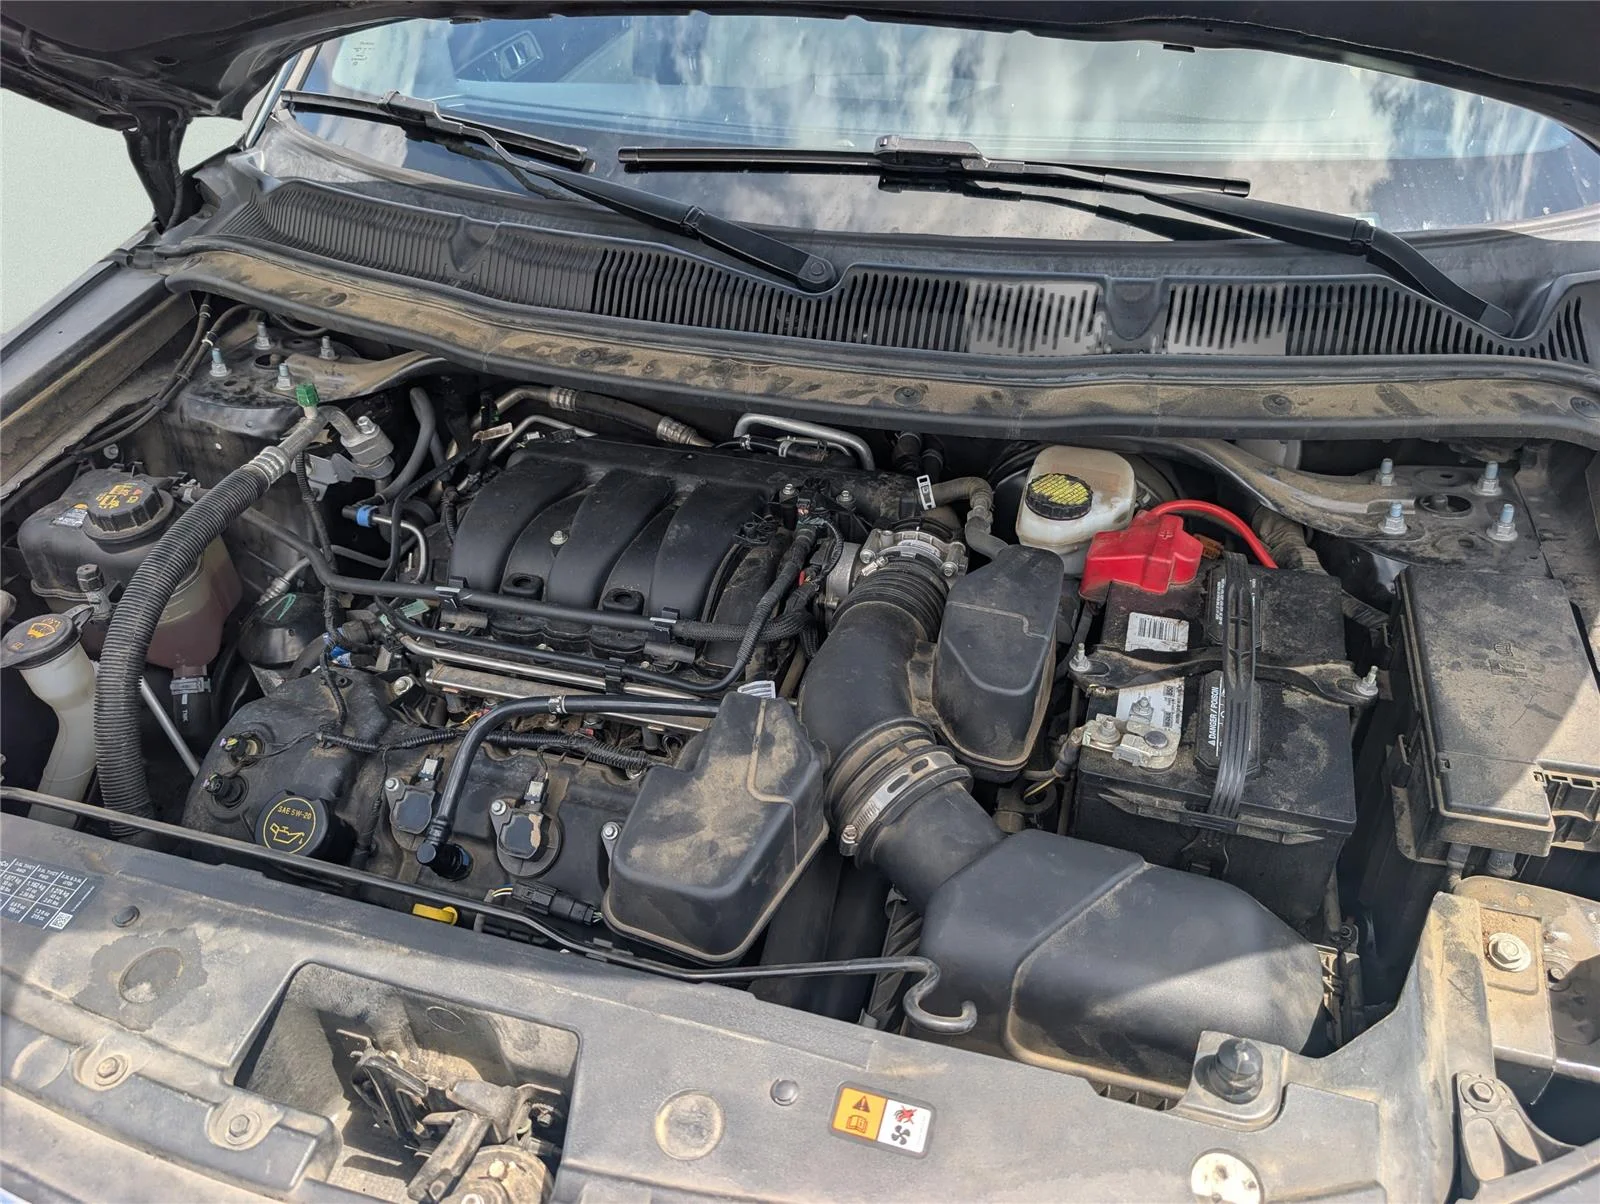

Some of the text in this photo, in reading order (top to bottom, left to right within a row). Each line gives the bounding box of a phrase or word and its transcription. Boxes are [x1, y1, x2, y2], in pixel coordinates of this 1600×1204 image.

[1211, 686, 1219, 709] POISON
[1209, 714, 1217, 739] DANGER
[277, 805, 312, 820] SAE 5W-20
